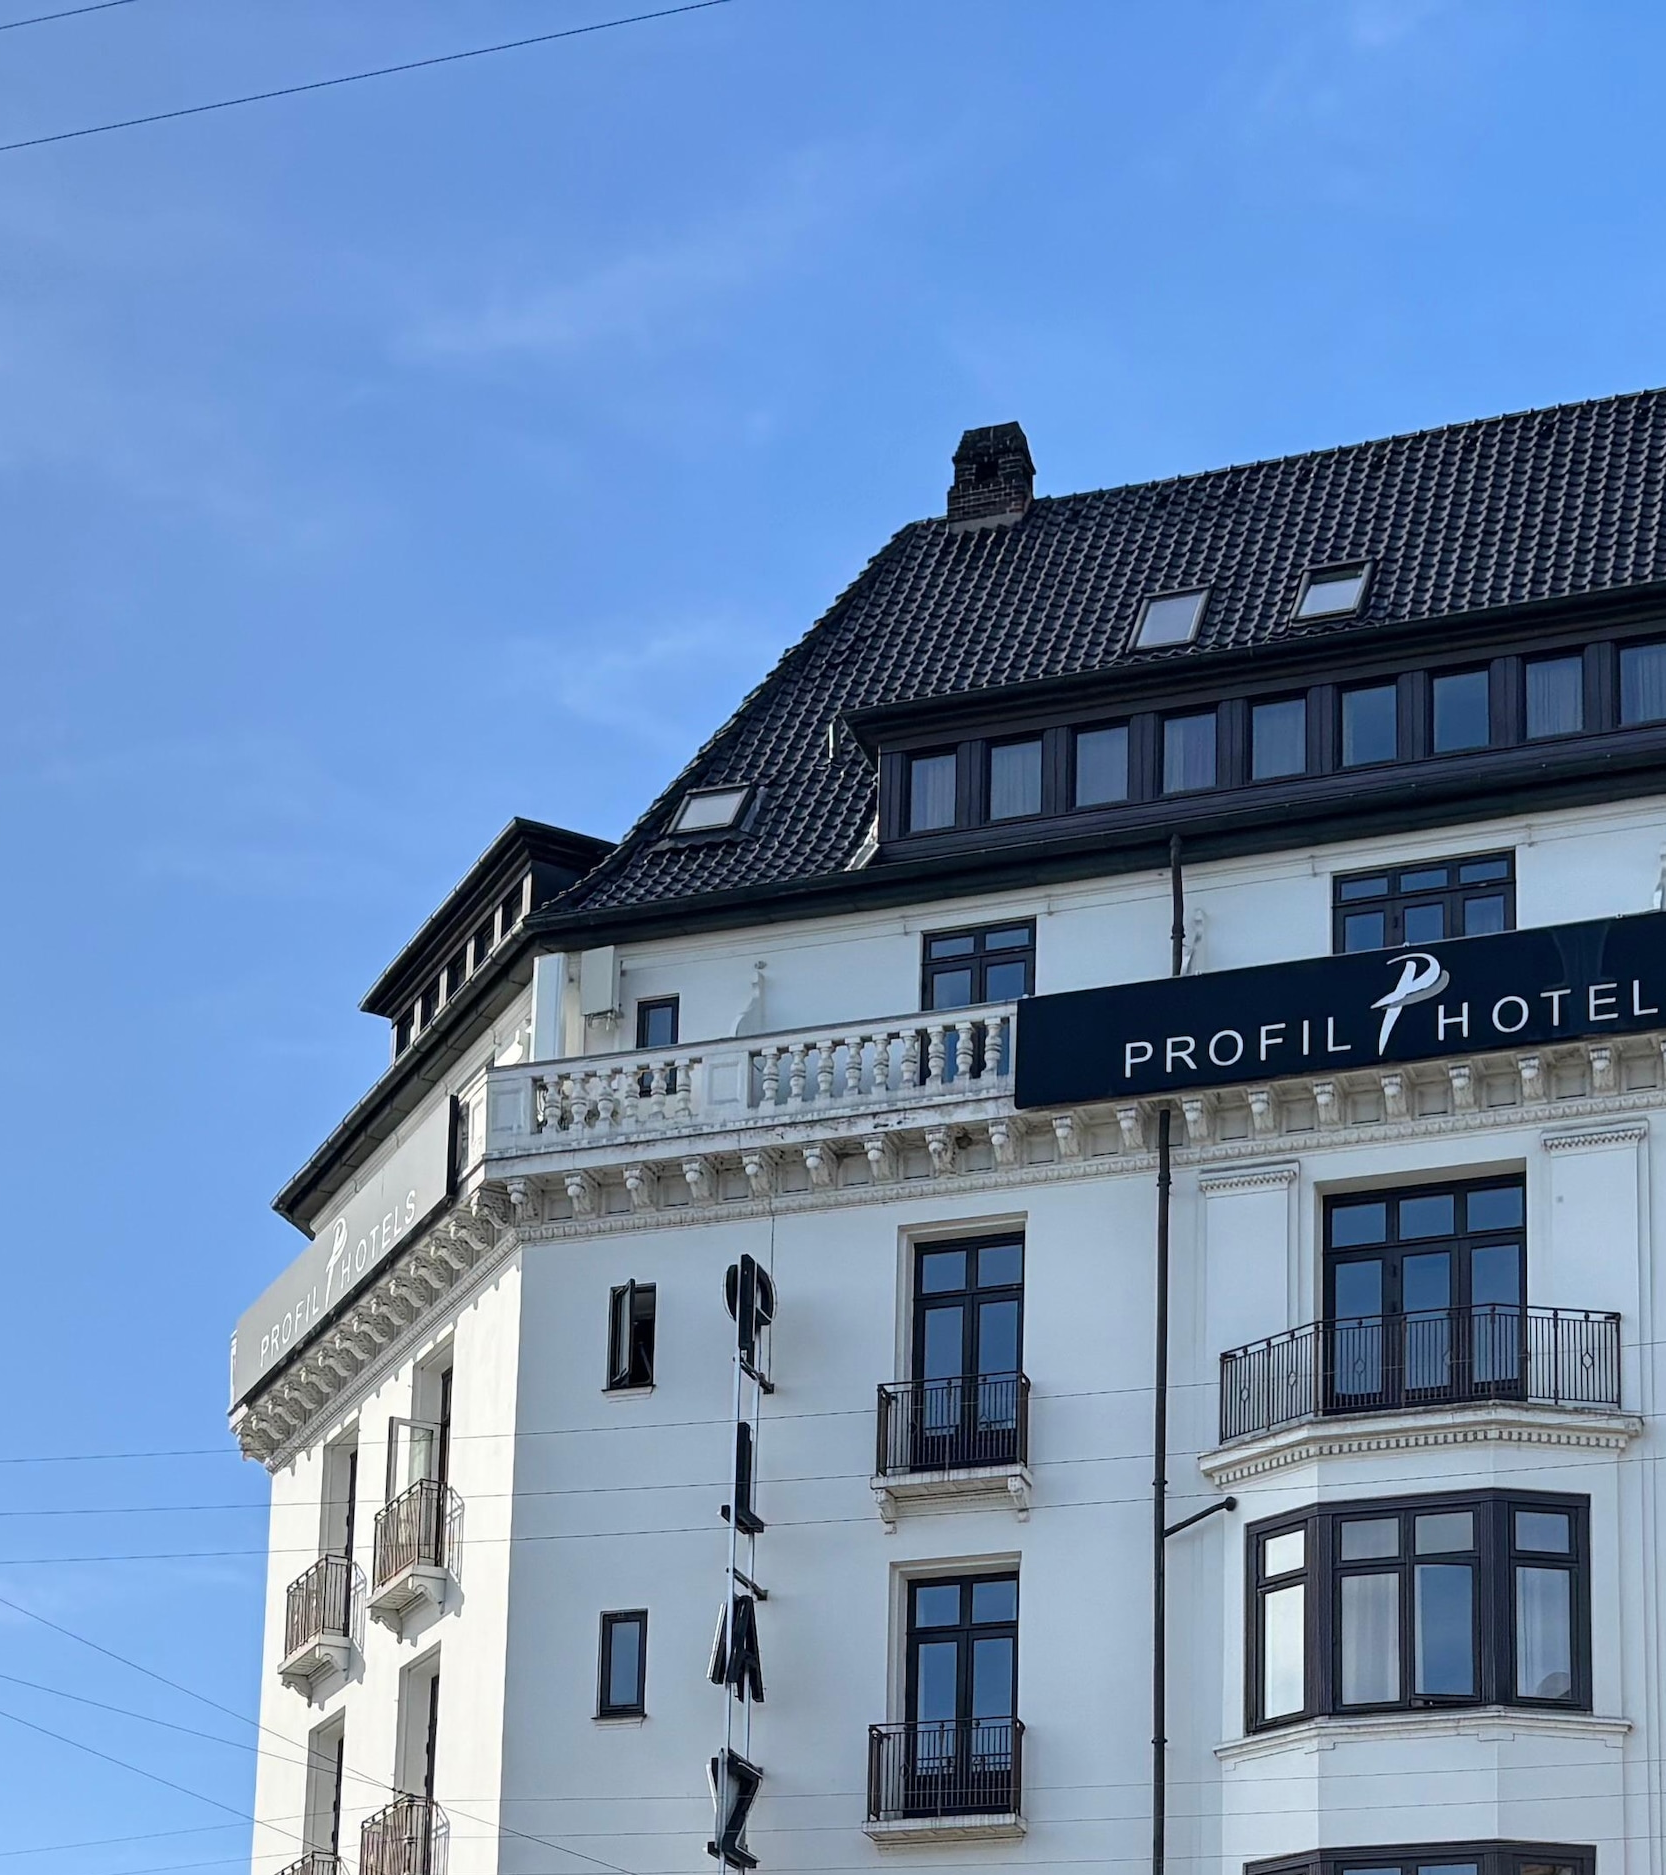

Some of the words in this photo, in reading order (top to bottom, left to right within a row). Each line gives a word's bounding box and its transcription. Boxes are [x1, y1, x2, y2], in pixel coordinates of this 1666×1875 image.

[1125, 1016, 1353, 1080] PROFIL
[259, 1285, 320, 1368] PROFIL
[340, 1189, 416, 1290] HOTELS
